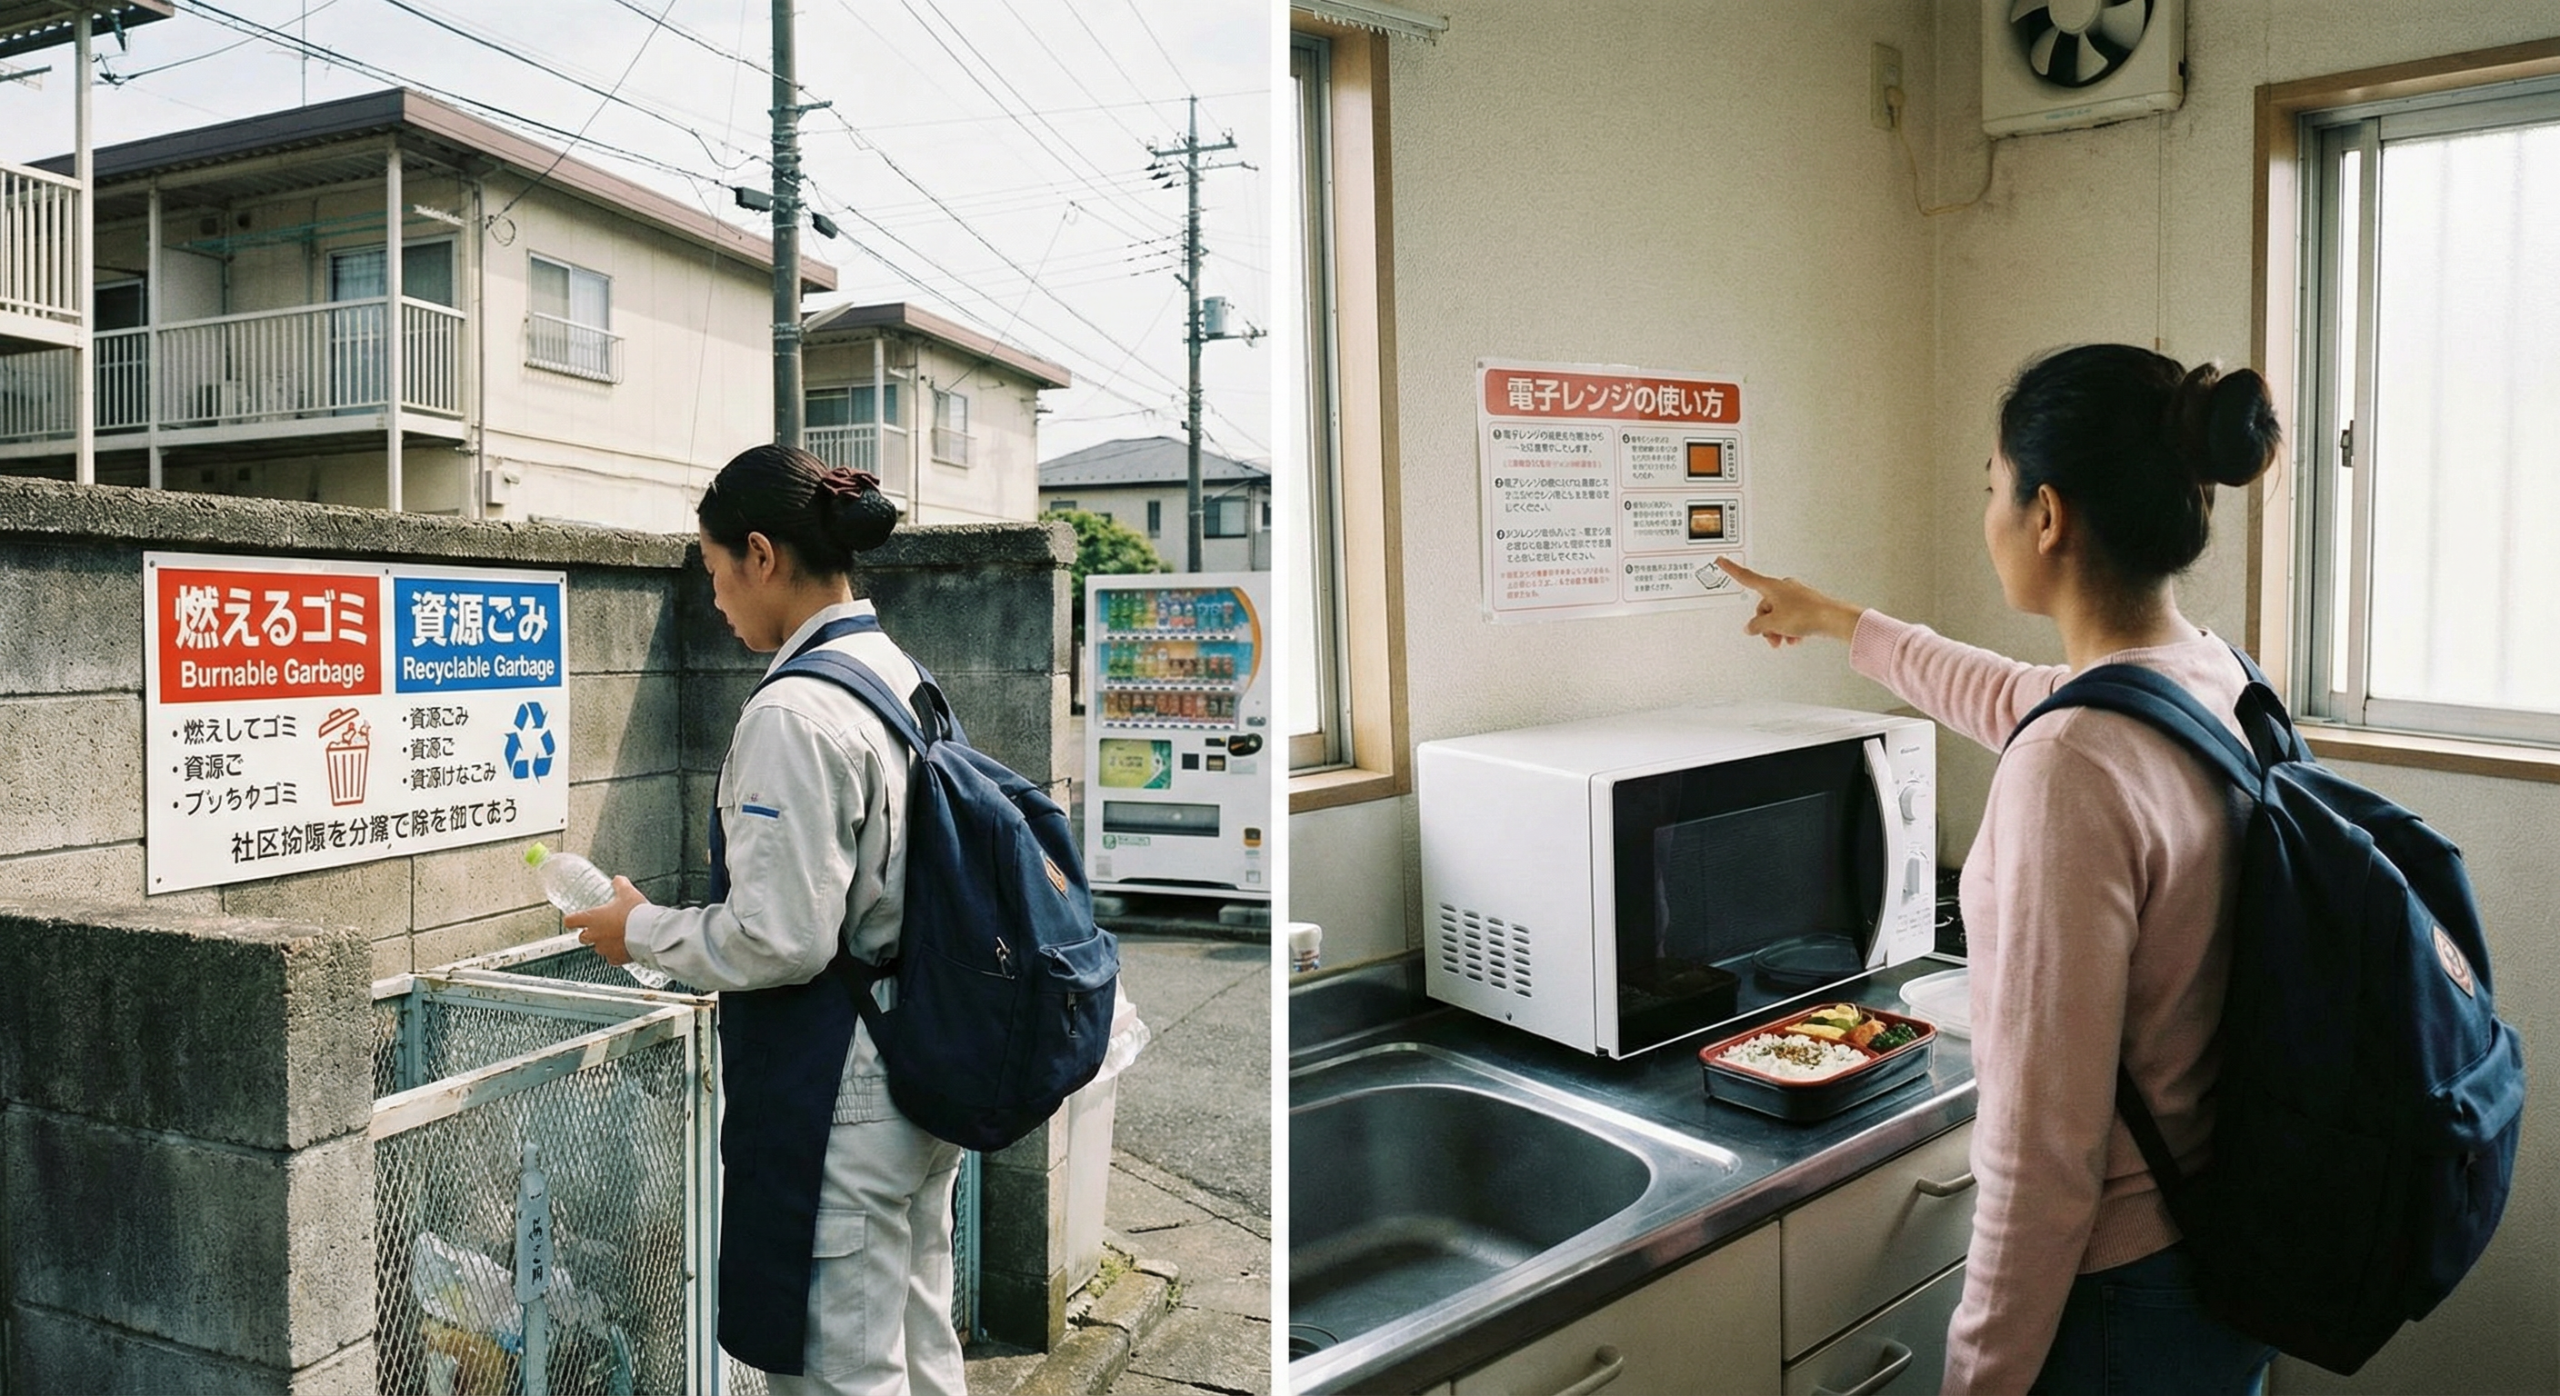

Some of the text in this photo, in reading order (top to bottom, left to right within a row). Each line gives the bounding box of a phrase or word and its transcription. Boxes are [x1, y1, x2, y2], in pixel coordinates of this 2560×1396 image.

[1507, 377, 1724, 418] 電子レンジの使い方
[174, 585, 368, 650] 燃えるゴミ
[411, 591, 549, 648] 資源ごみ
[181, 658, 365, 689] Burnable Garbage
[403, 655, 555, 686] Recyclable Garbage
